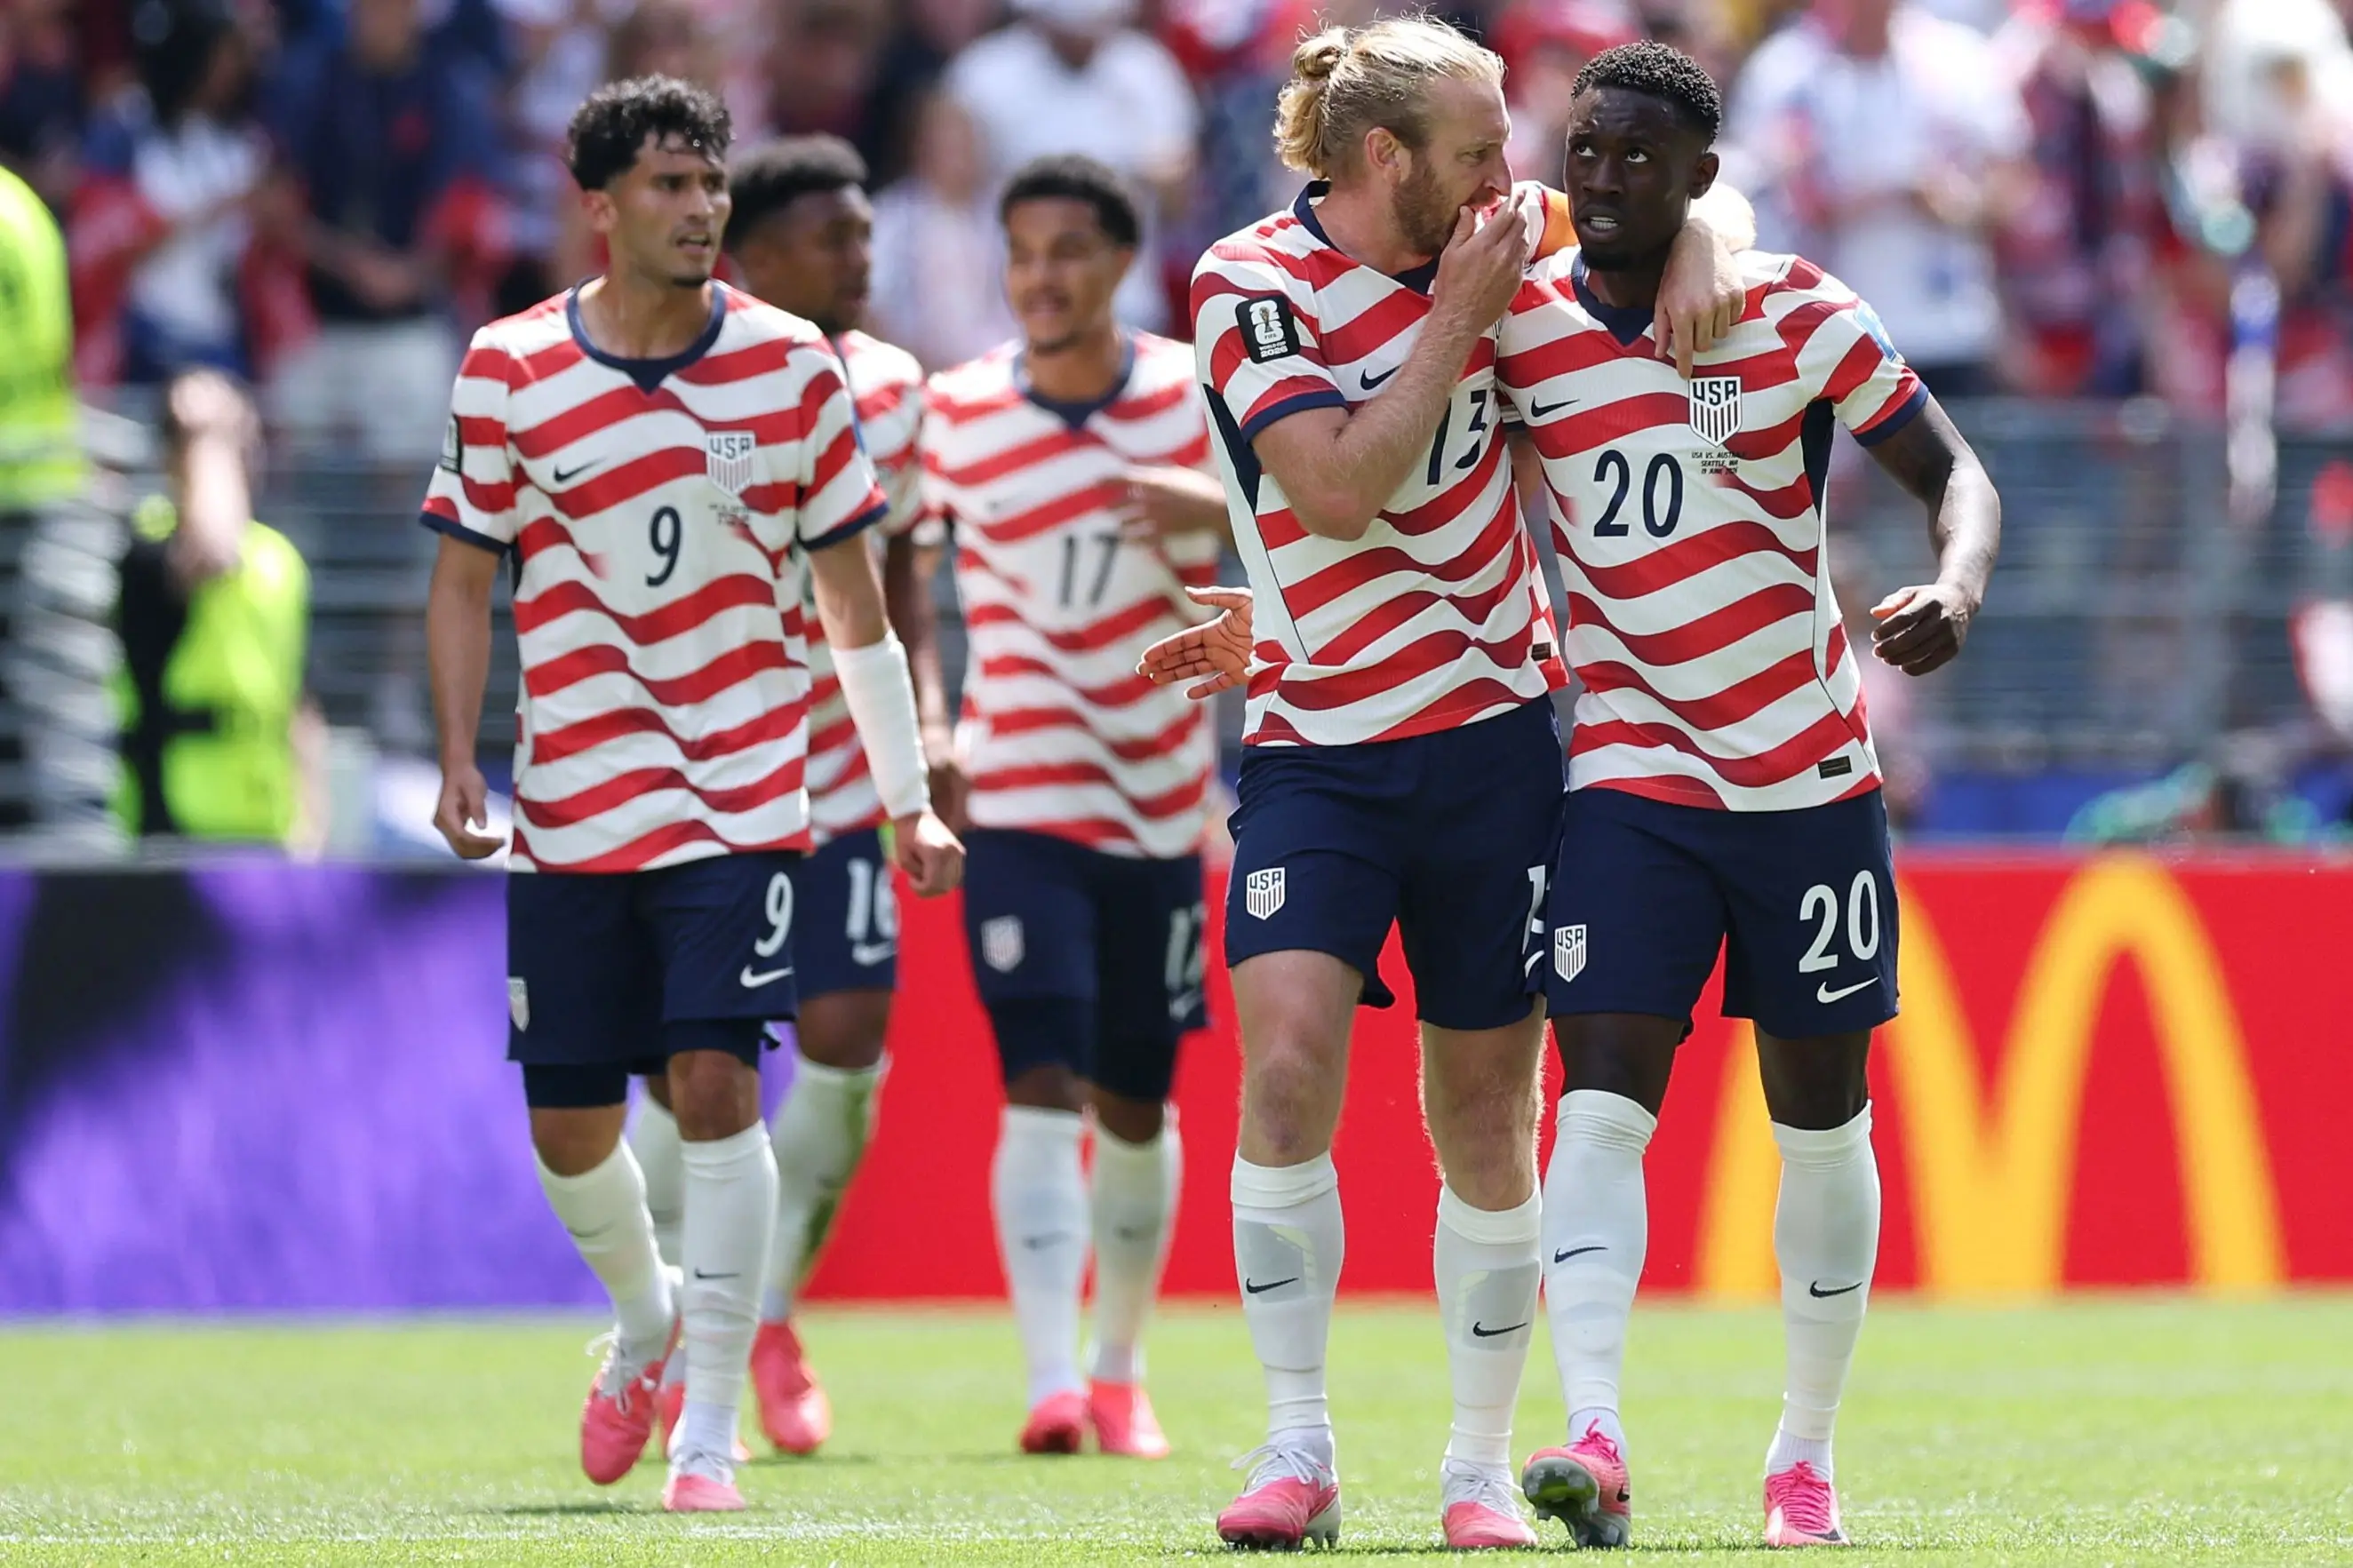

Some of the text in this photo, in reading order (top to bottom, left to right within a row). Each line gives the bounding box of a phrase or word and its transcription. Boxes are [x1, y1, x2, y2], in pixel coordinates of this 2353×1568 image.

[1261, 346, 1288, 357] 2026
[1693, 380, 1737, 406] USA
[709, 436, 750, 459] USA
[1427, 389, 1488, 486] 13
[1593, 449, 1684, 538] 20
[646, 505, 682, 588] 9
[1060, 533, 1121, 609] 17
[754, 872, 794, 958] 9
[1249, 871, 1282, 891] USA
[1556, 928, 1583, 950] USA
[1799, 869, 1879, 974] 20
